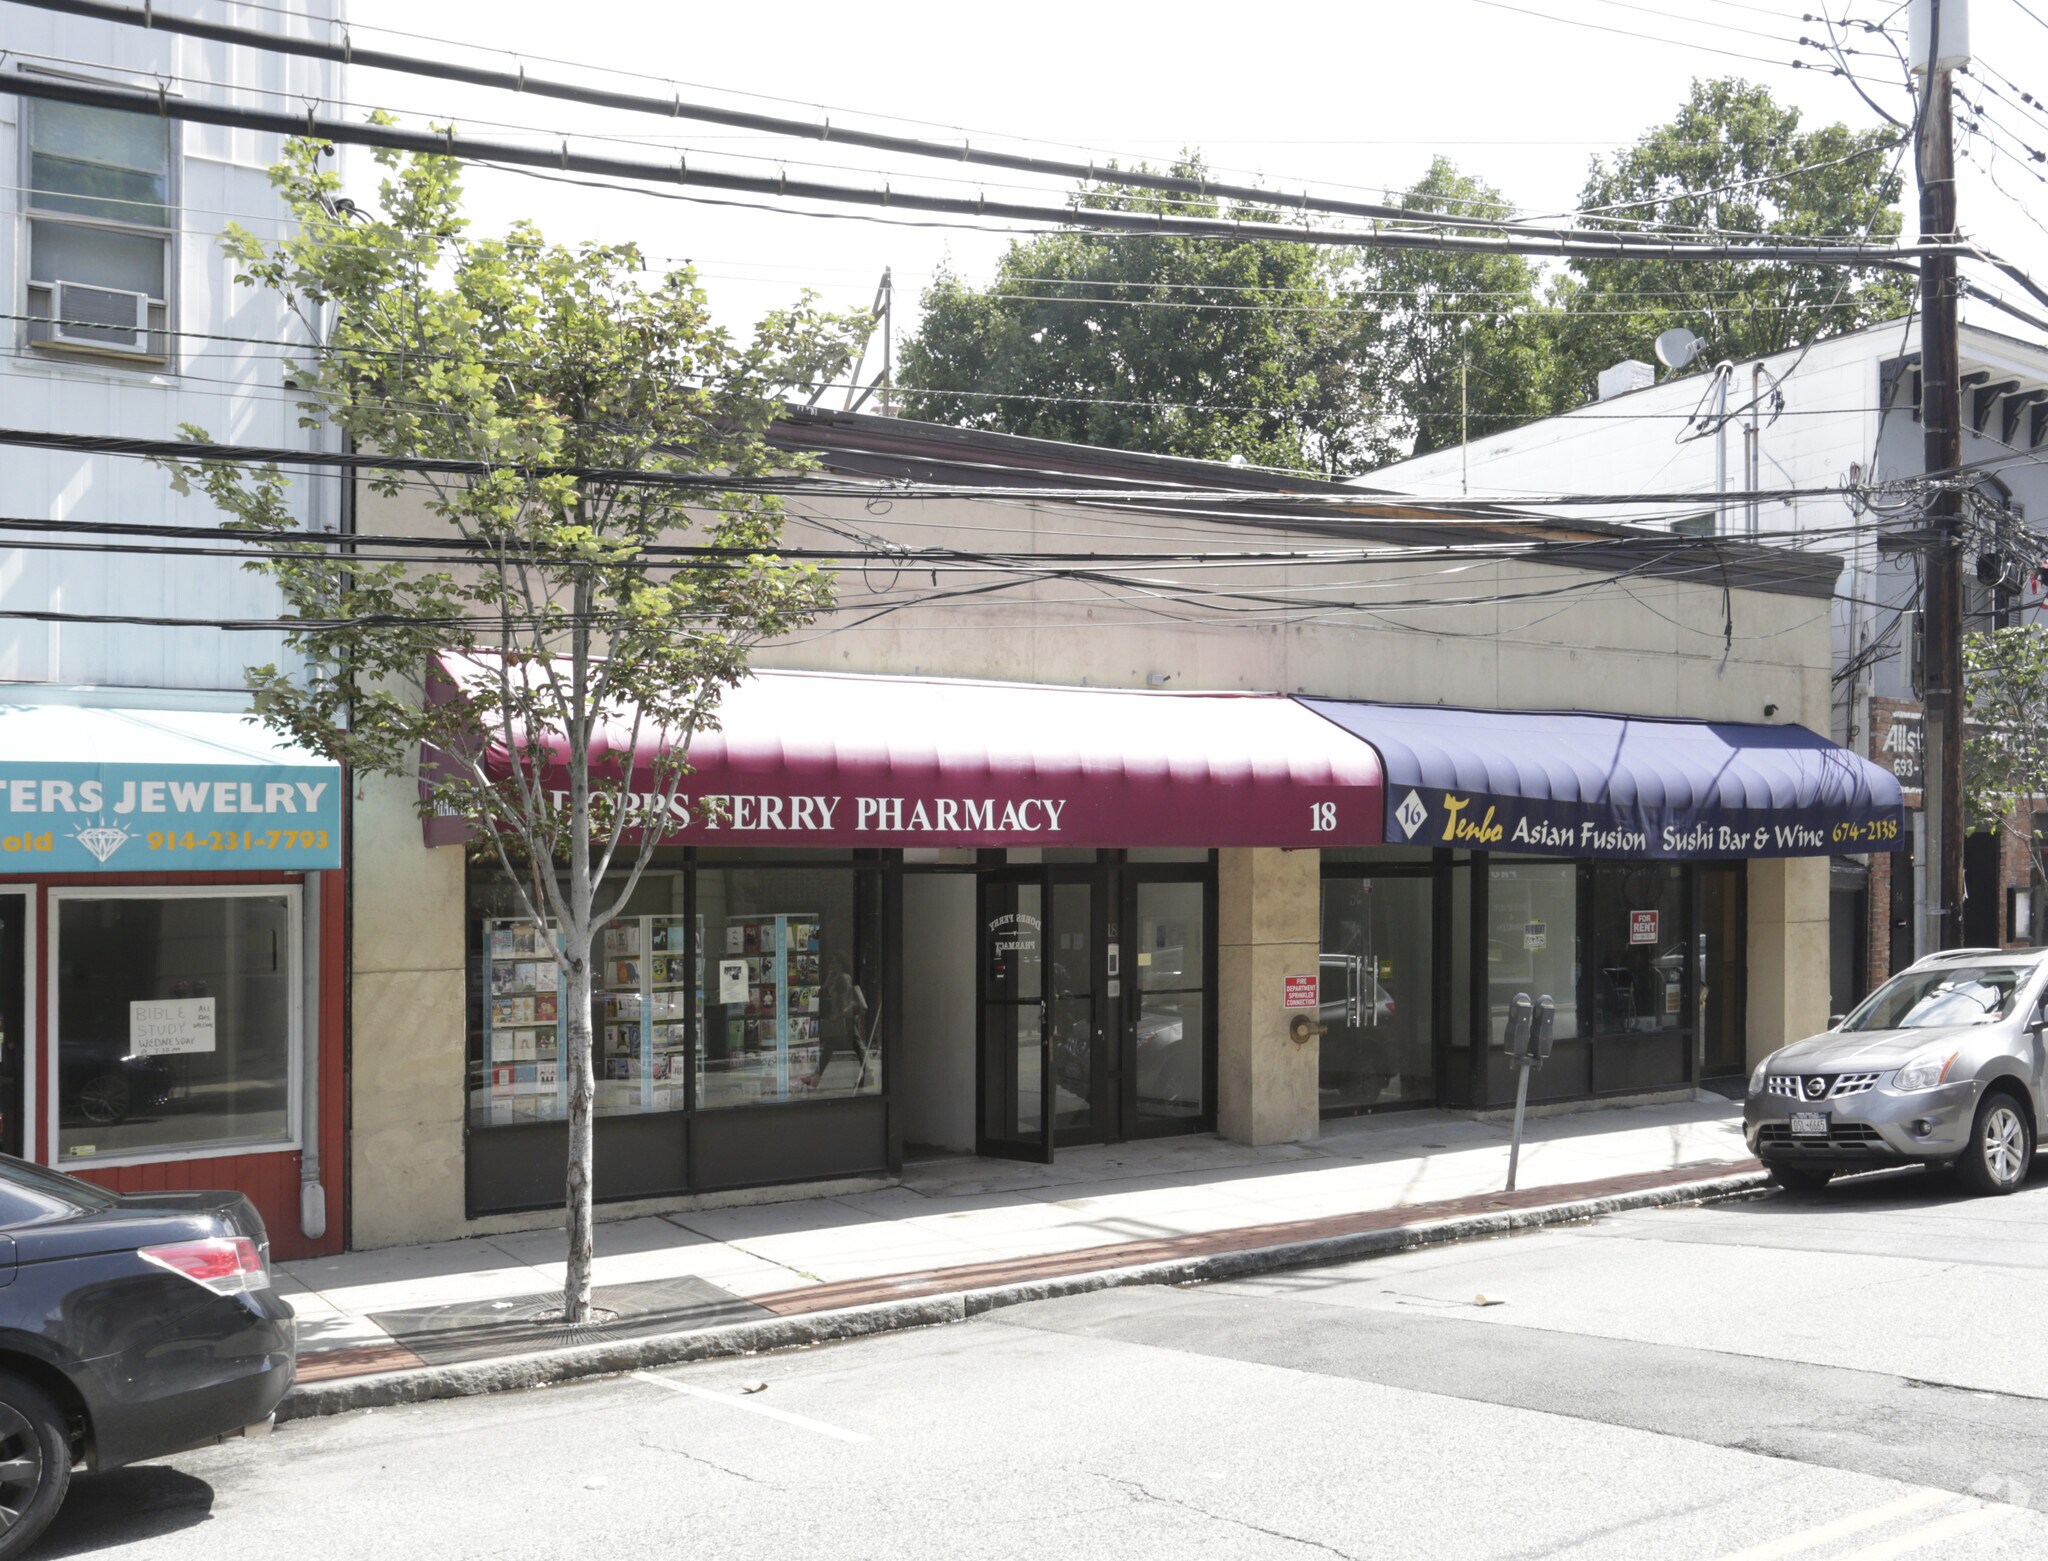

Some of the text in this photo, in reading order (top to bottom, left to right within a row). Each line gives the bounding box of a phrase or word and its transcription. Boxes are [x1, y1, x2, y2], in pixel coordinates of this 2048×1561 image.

[1881, 723, 1924, 753] Allst
[1893, 758, 1922, 777] 693-
[113, 780, 329, 813] JEWELRY
[704, 794, 841, 831] FERRY
[854, 796, 1066, 832] PHARMACY
[1309, 801, 1338, 832] 18
[1403, 802, 1422, 826] 16
[1511, 815, 1575, 847] Asian
[1580, 821, 1647, 851] Fusion
[1662, 823, 1714, 851] Sushi
[1718, 825, 1751, 851] Bar
[1752, 826, 1771, 850] &
[1774, 823, 1824, 849] Wine
[1832, 819, 1898, 843] 674-2138
[0, 829, 330, 852] old 914-231-7793
[1638, 914, 1652, 923] FOR
[1633, 922, 1656, 933] RENT
[1286, 984, 1316, 992] DEPARTMENT
[1296, 977, 1307, 985] FIRE
[1286, 998, 1316, 1006] CONNECTION
[1288, 991, 1314, 999] SPRINKLER
[136, 1007, 186, 1021] BIBLE
[198, 1004, 211, 1012] ALL
[137, 1022, 186, 1037] STUDY
[138, 1036, 196, 1048] WEDNESDAY
